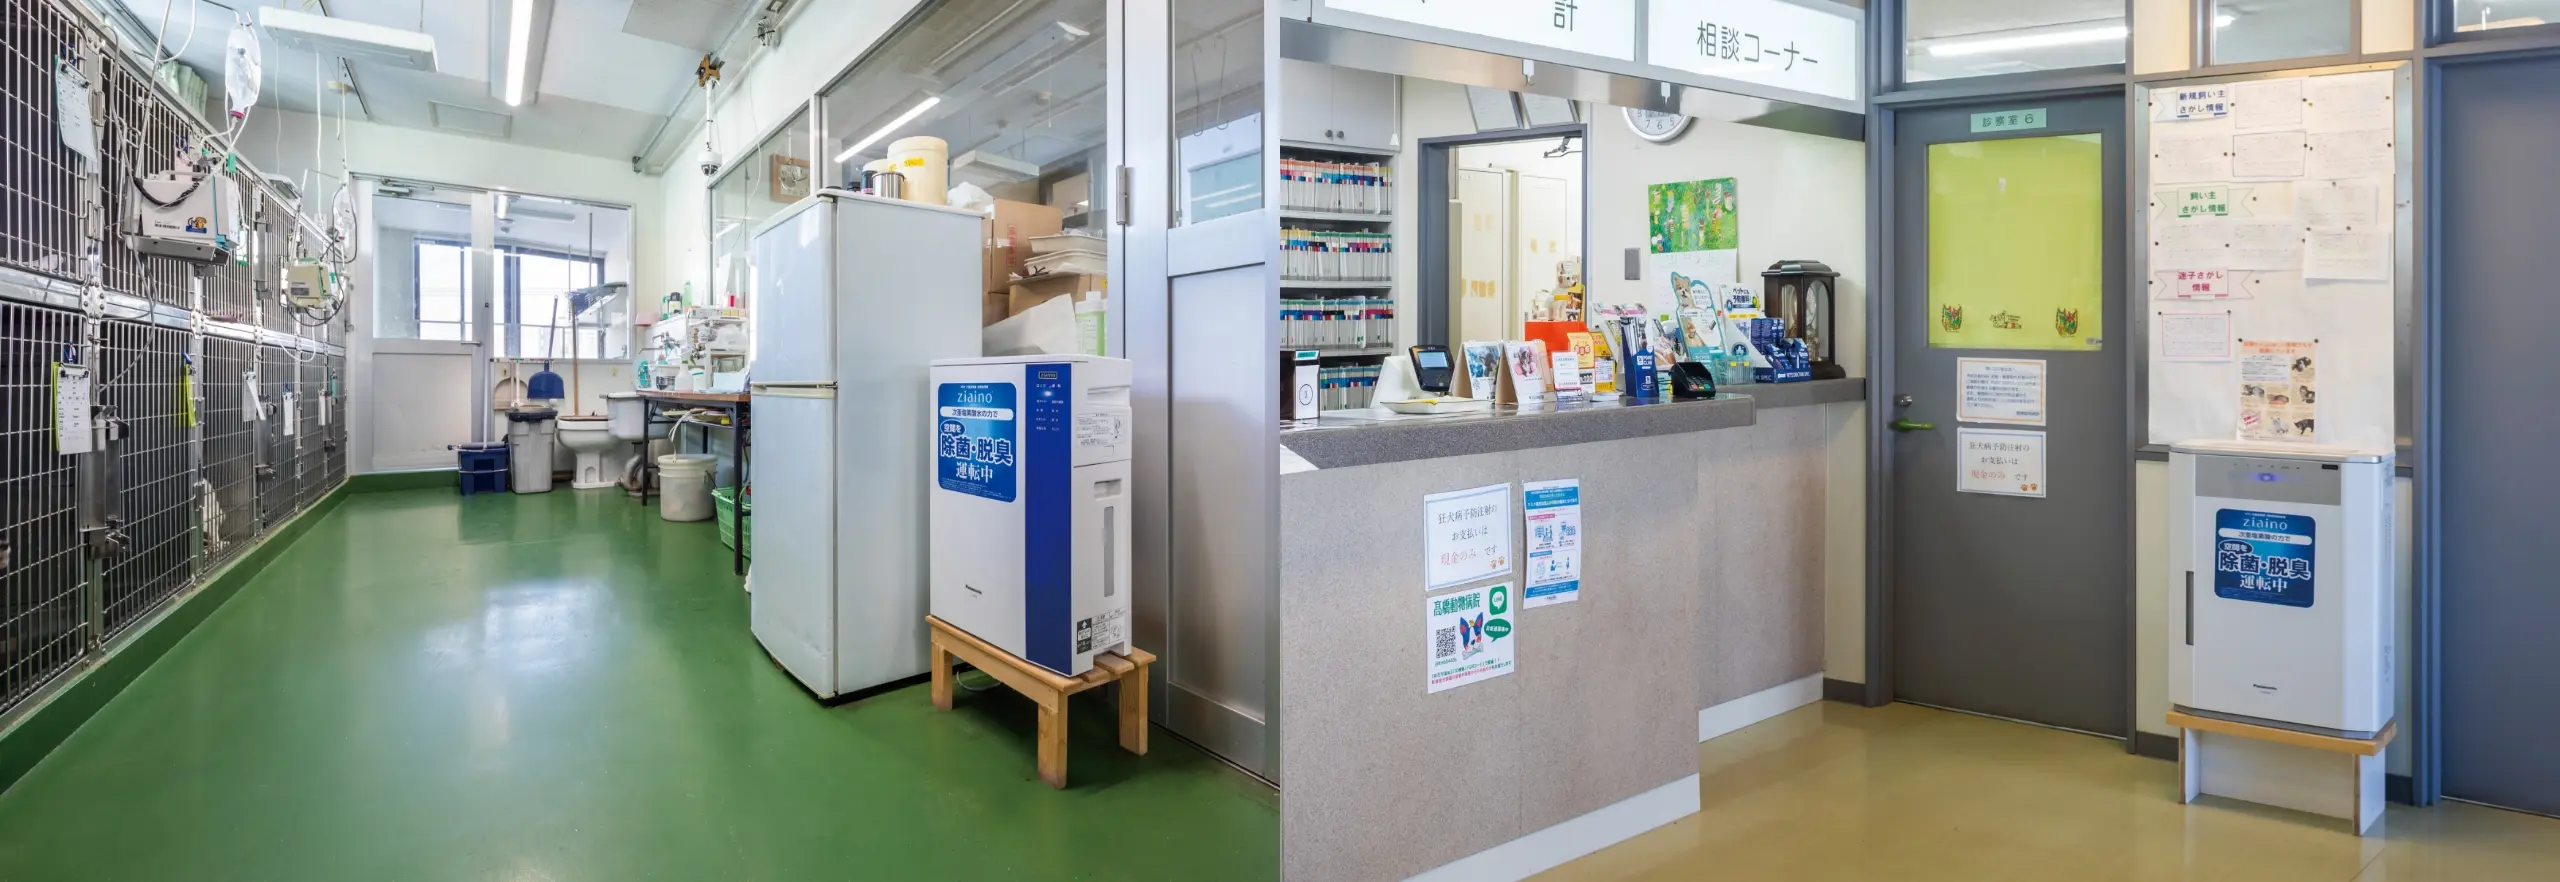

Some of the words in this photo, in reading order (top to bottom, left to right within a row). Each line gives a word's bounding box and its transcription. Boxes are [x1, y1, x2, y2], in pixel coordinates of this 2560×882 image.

[1553, 0, 1578, 32] 計
[1696, 20, 1819, 72] 相談コーナー
[2179, 90, 2226, 101] 新規飼い主
[2180, 103, 2224, 113] さがし情報
[1982, 115, 2018, 128] 診察室
[2024, 113, 2034, 124] 6
[2189, 191, 2216, 201] 飼い主
[2182, 204, 2226, 214] さがし情報
[2177, 271, 2224, 281] 迷子さがし
[2191, 283, 2210, 292] 情報
[957, 390, 993, 404] ziaino
[951, 408, 999, 418] 次亜塩素酸水の力で
[943, 423, 962, 433] 空間を
[940, 435, 1013, 466] 除菌・脱臭
[1969, 441, 2030, 452] 狂犬病予防注射の
[1981, 456, 2018, 465] お支払いは
[956, 461, 993, 484] 運転中
[1971, 469, 2006, 480] 現金のみ
[2014, 473, 2028, 481] です
[1438, 504, 1497, 525] 狂犬病予防注射の
[2243, 517, 2288, 530] ziaino
[1451, 525, 1488, 541] お支払いは
[2238, 531, 2291, 542] 次亜塩素酸の力で
[2223, 542, 2248, 552] 空間を
[1440, 549, 1477, 566] 現金のみ
[1484, 545, 1499, 556] です
[2218, 551, 2311, 580] 除菌・脱臭
[2239, 574, 2288, 593] 運転中
